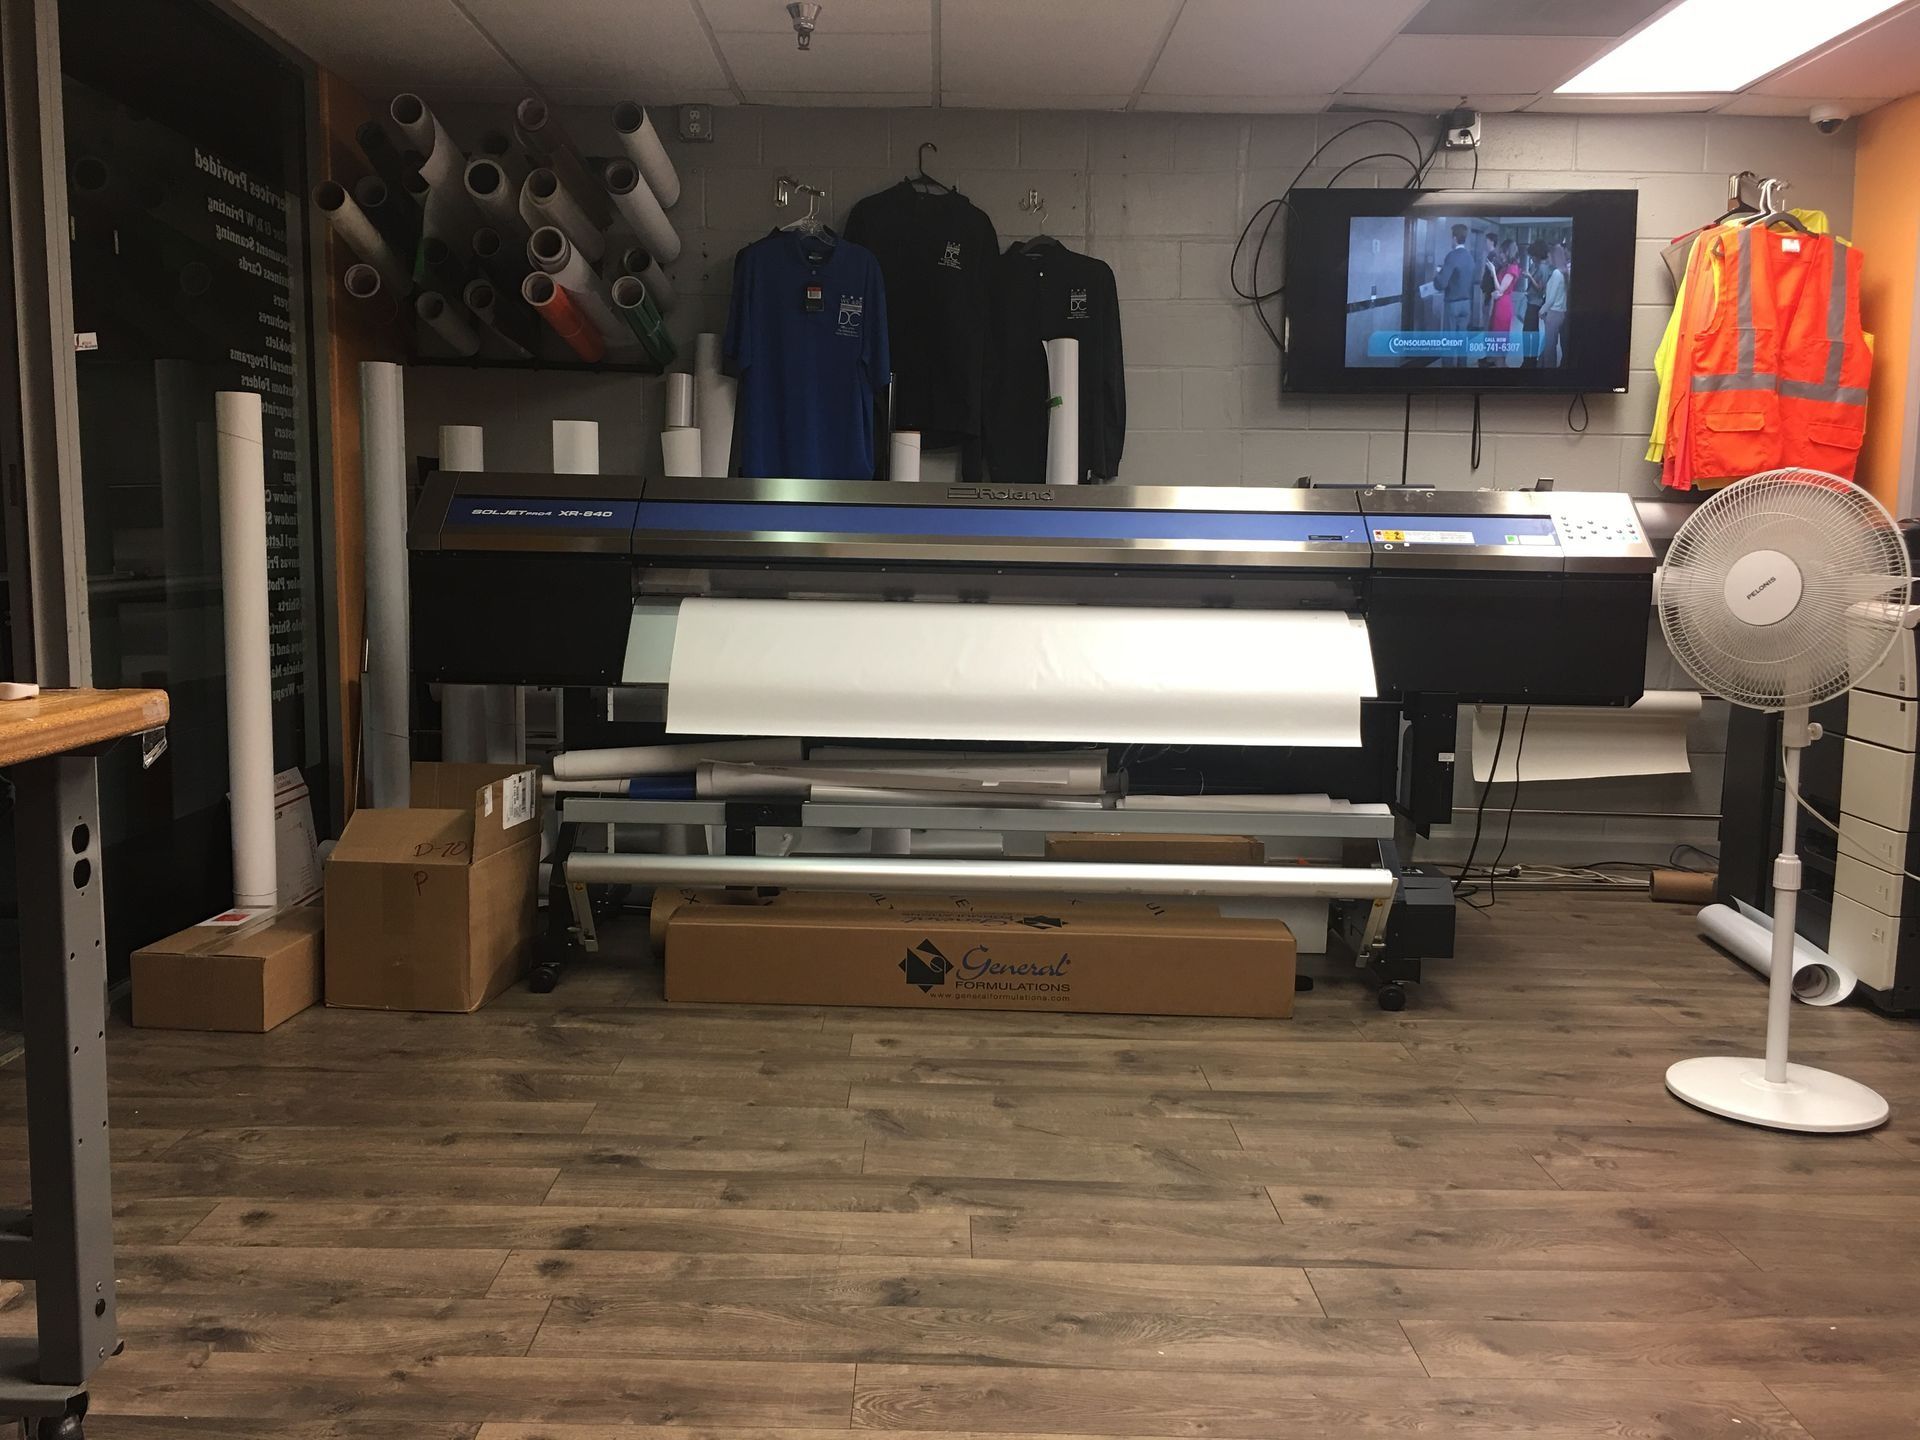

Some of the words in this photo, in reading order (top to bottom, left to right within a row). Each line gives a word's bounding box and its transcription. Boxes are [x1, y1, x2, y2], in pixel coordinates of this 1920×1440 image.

[1070, 300, 1087, 311] DC
[838, 310, 861, 326] DC
[1468, 343, 1520, 352] 800-741-6307
[979, 488, 1055, 502] Roland
[1746, 576, 1777, 601] PELONIS
[413, 870, 428, 897] P
[956, 944, 1068, 982] General
[956, 981, 1071, 993] FORMULATIONS
[930, 992, 1071, 1002] www.generalformulations.com
